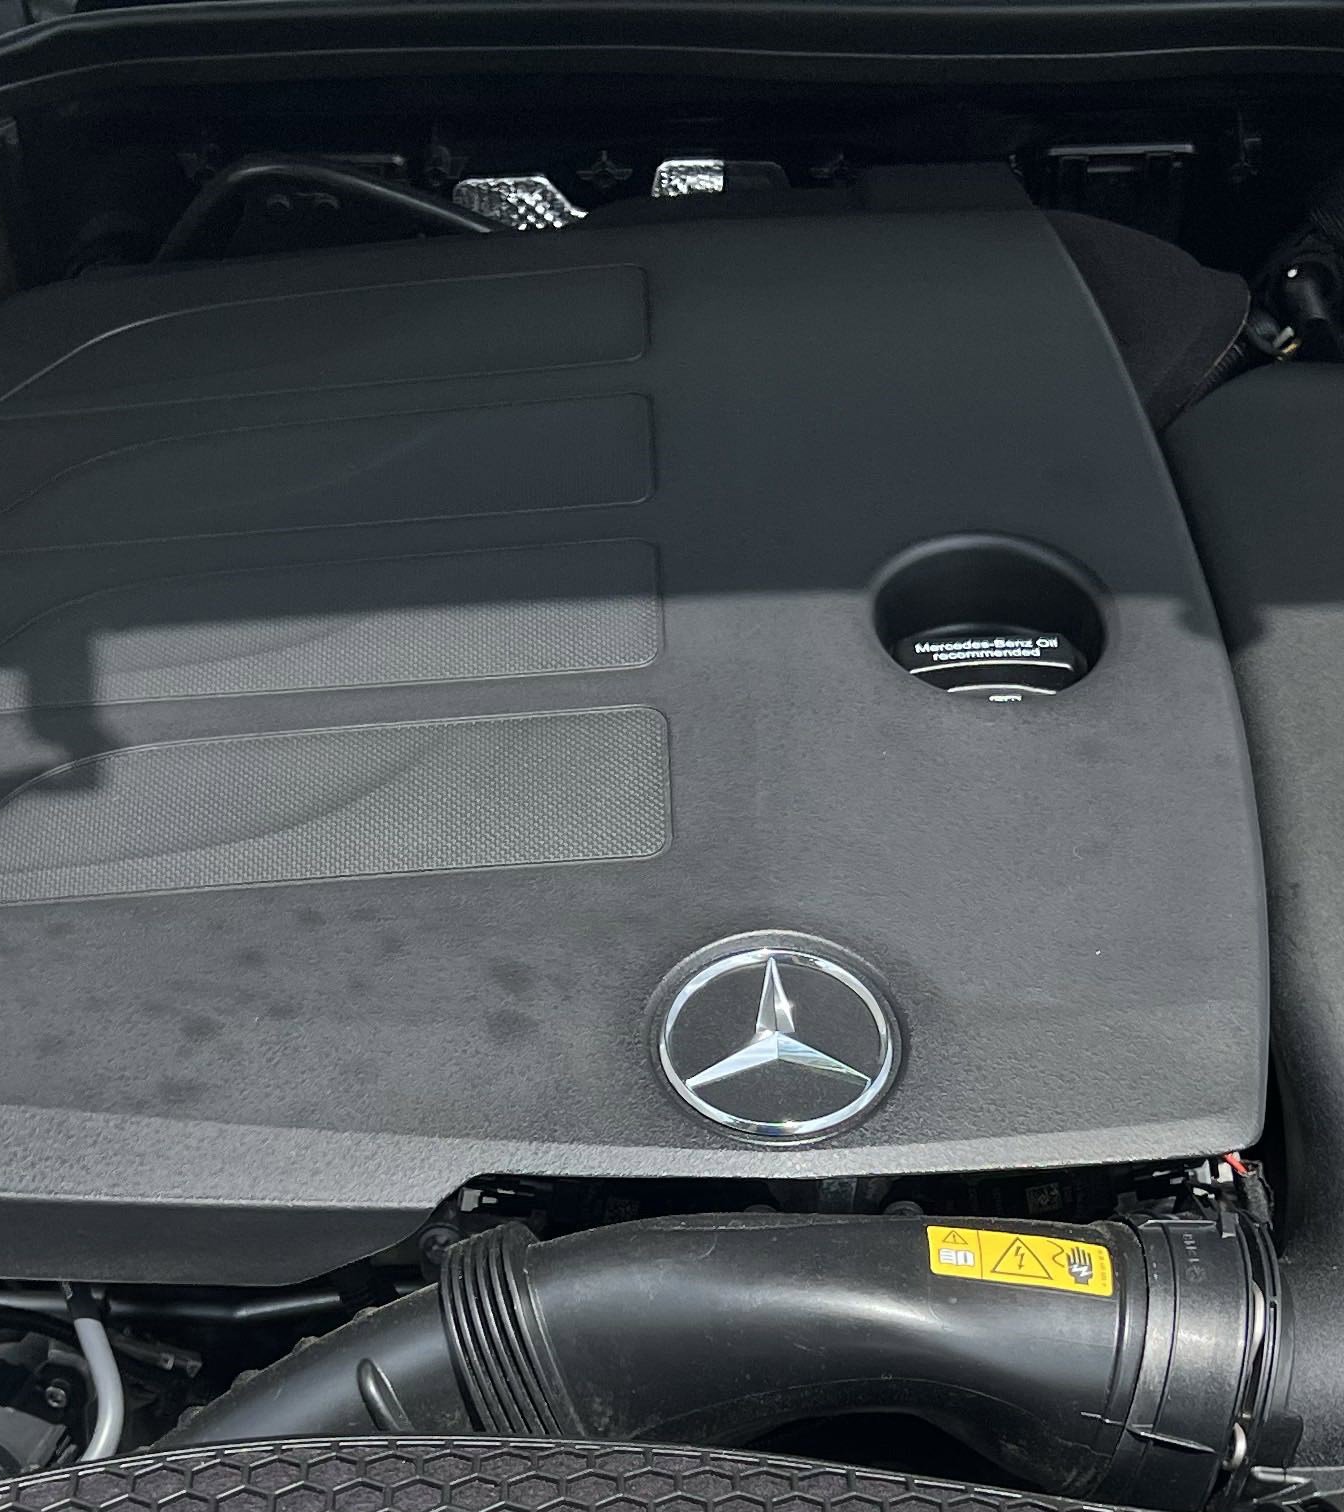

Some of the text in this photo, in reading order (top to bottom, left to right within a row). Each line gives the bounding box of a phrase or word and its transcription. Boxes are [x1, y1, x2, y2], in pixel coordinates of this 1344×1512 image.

[915, 637, 1058, 653] Mercedes-Benz Oil
[933, 647, 1041, 661] recommended
